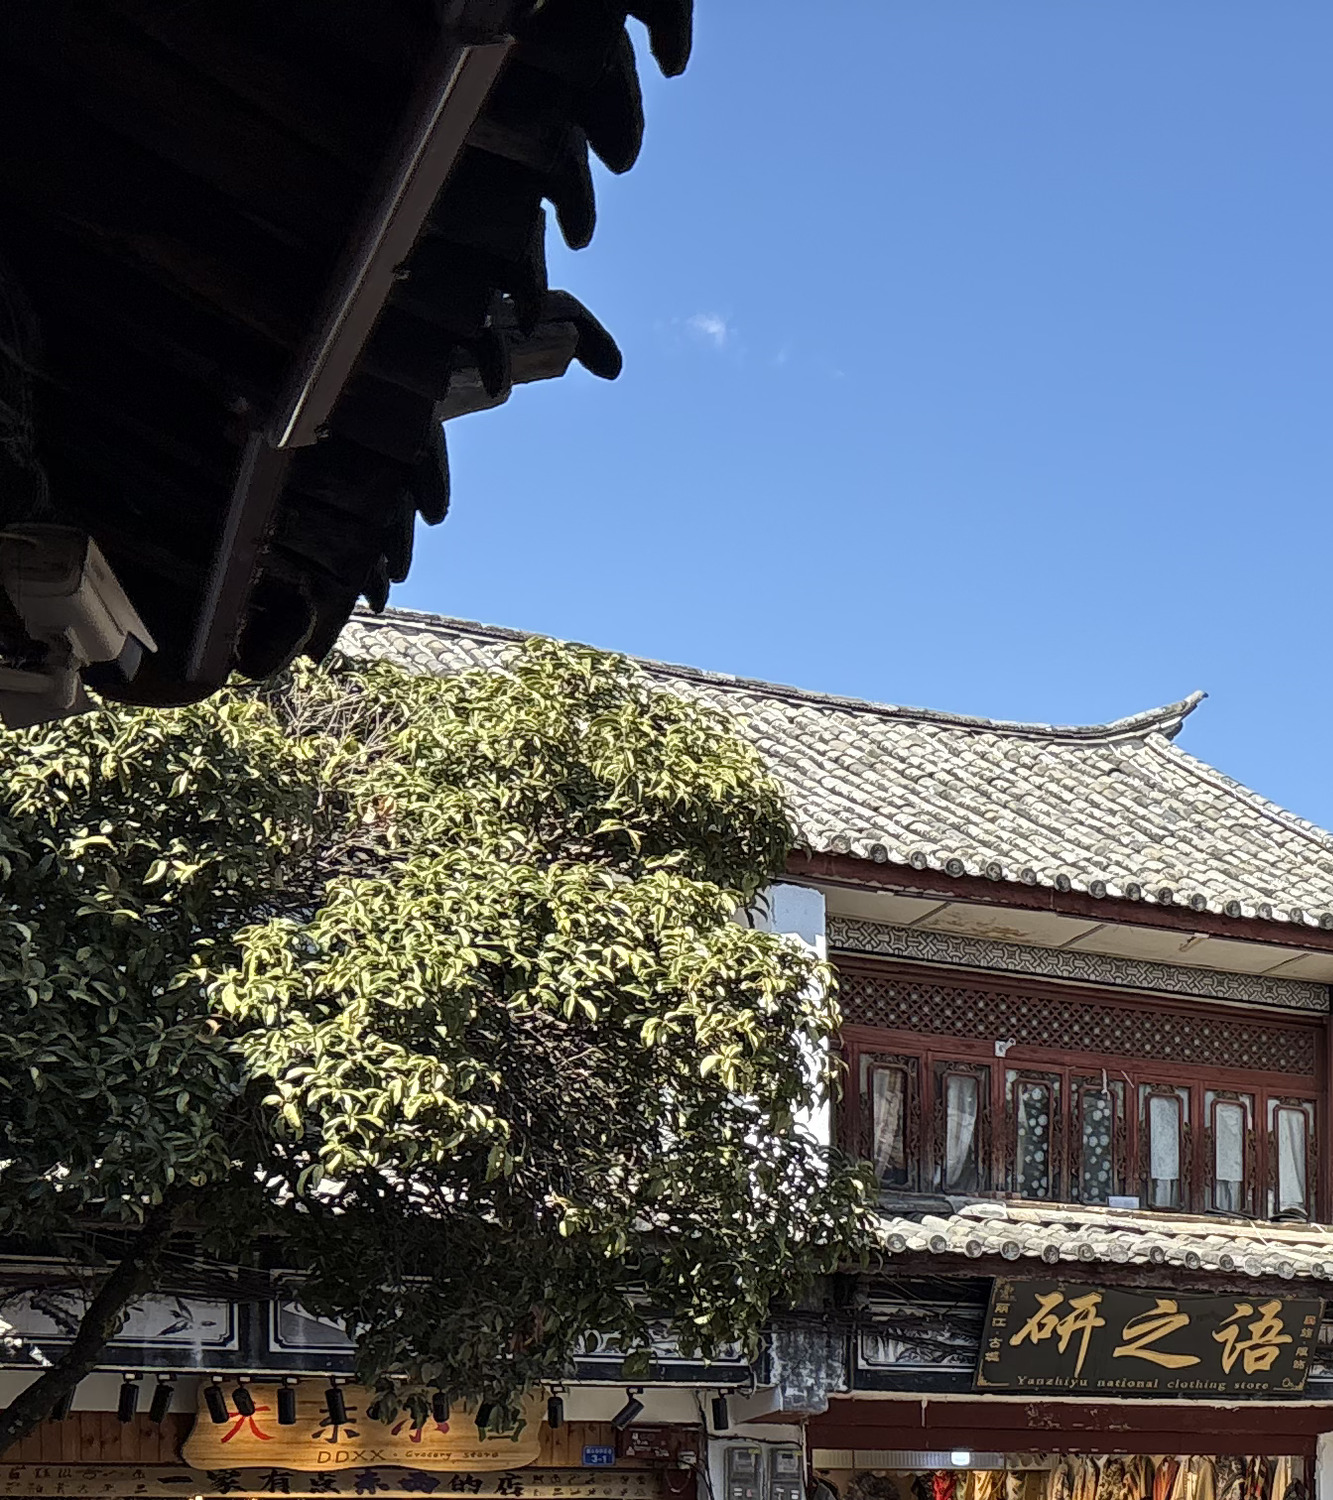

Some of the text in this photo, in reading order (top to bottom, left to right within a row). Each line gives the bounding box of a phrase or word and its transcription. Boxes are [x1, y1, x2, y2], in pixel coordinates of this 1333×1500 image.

[1008, 1290, 1293, 1378] 研之语
[1016, 1375, 1270, 1392] Yanzhiyu national clothing store
[316, 1449, 388, 1465] DDXX
[404, 1450, 452, 1461] Grocery
[157, 1470, 524, 1497] 一家有点东西的店
